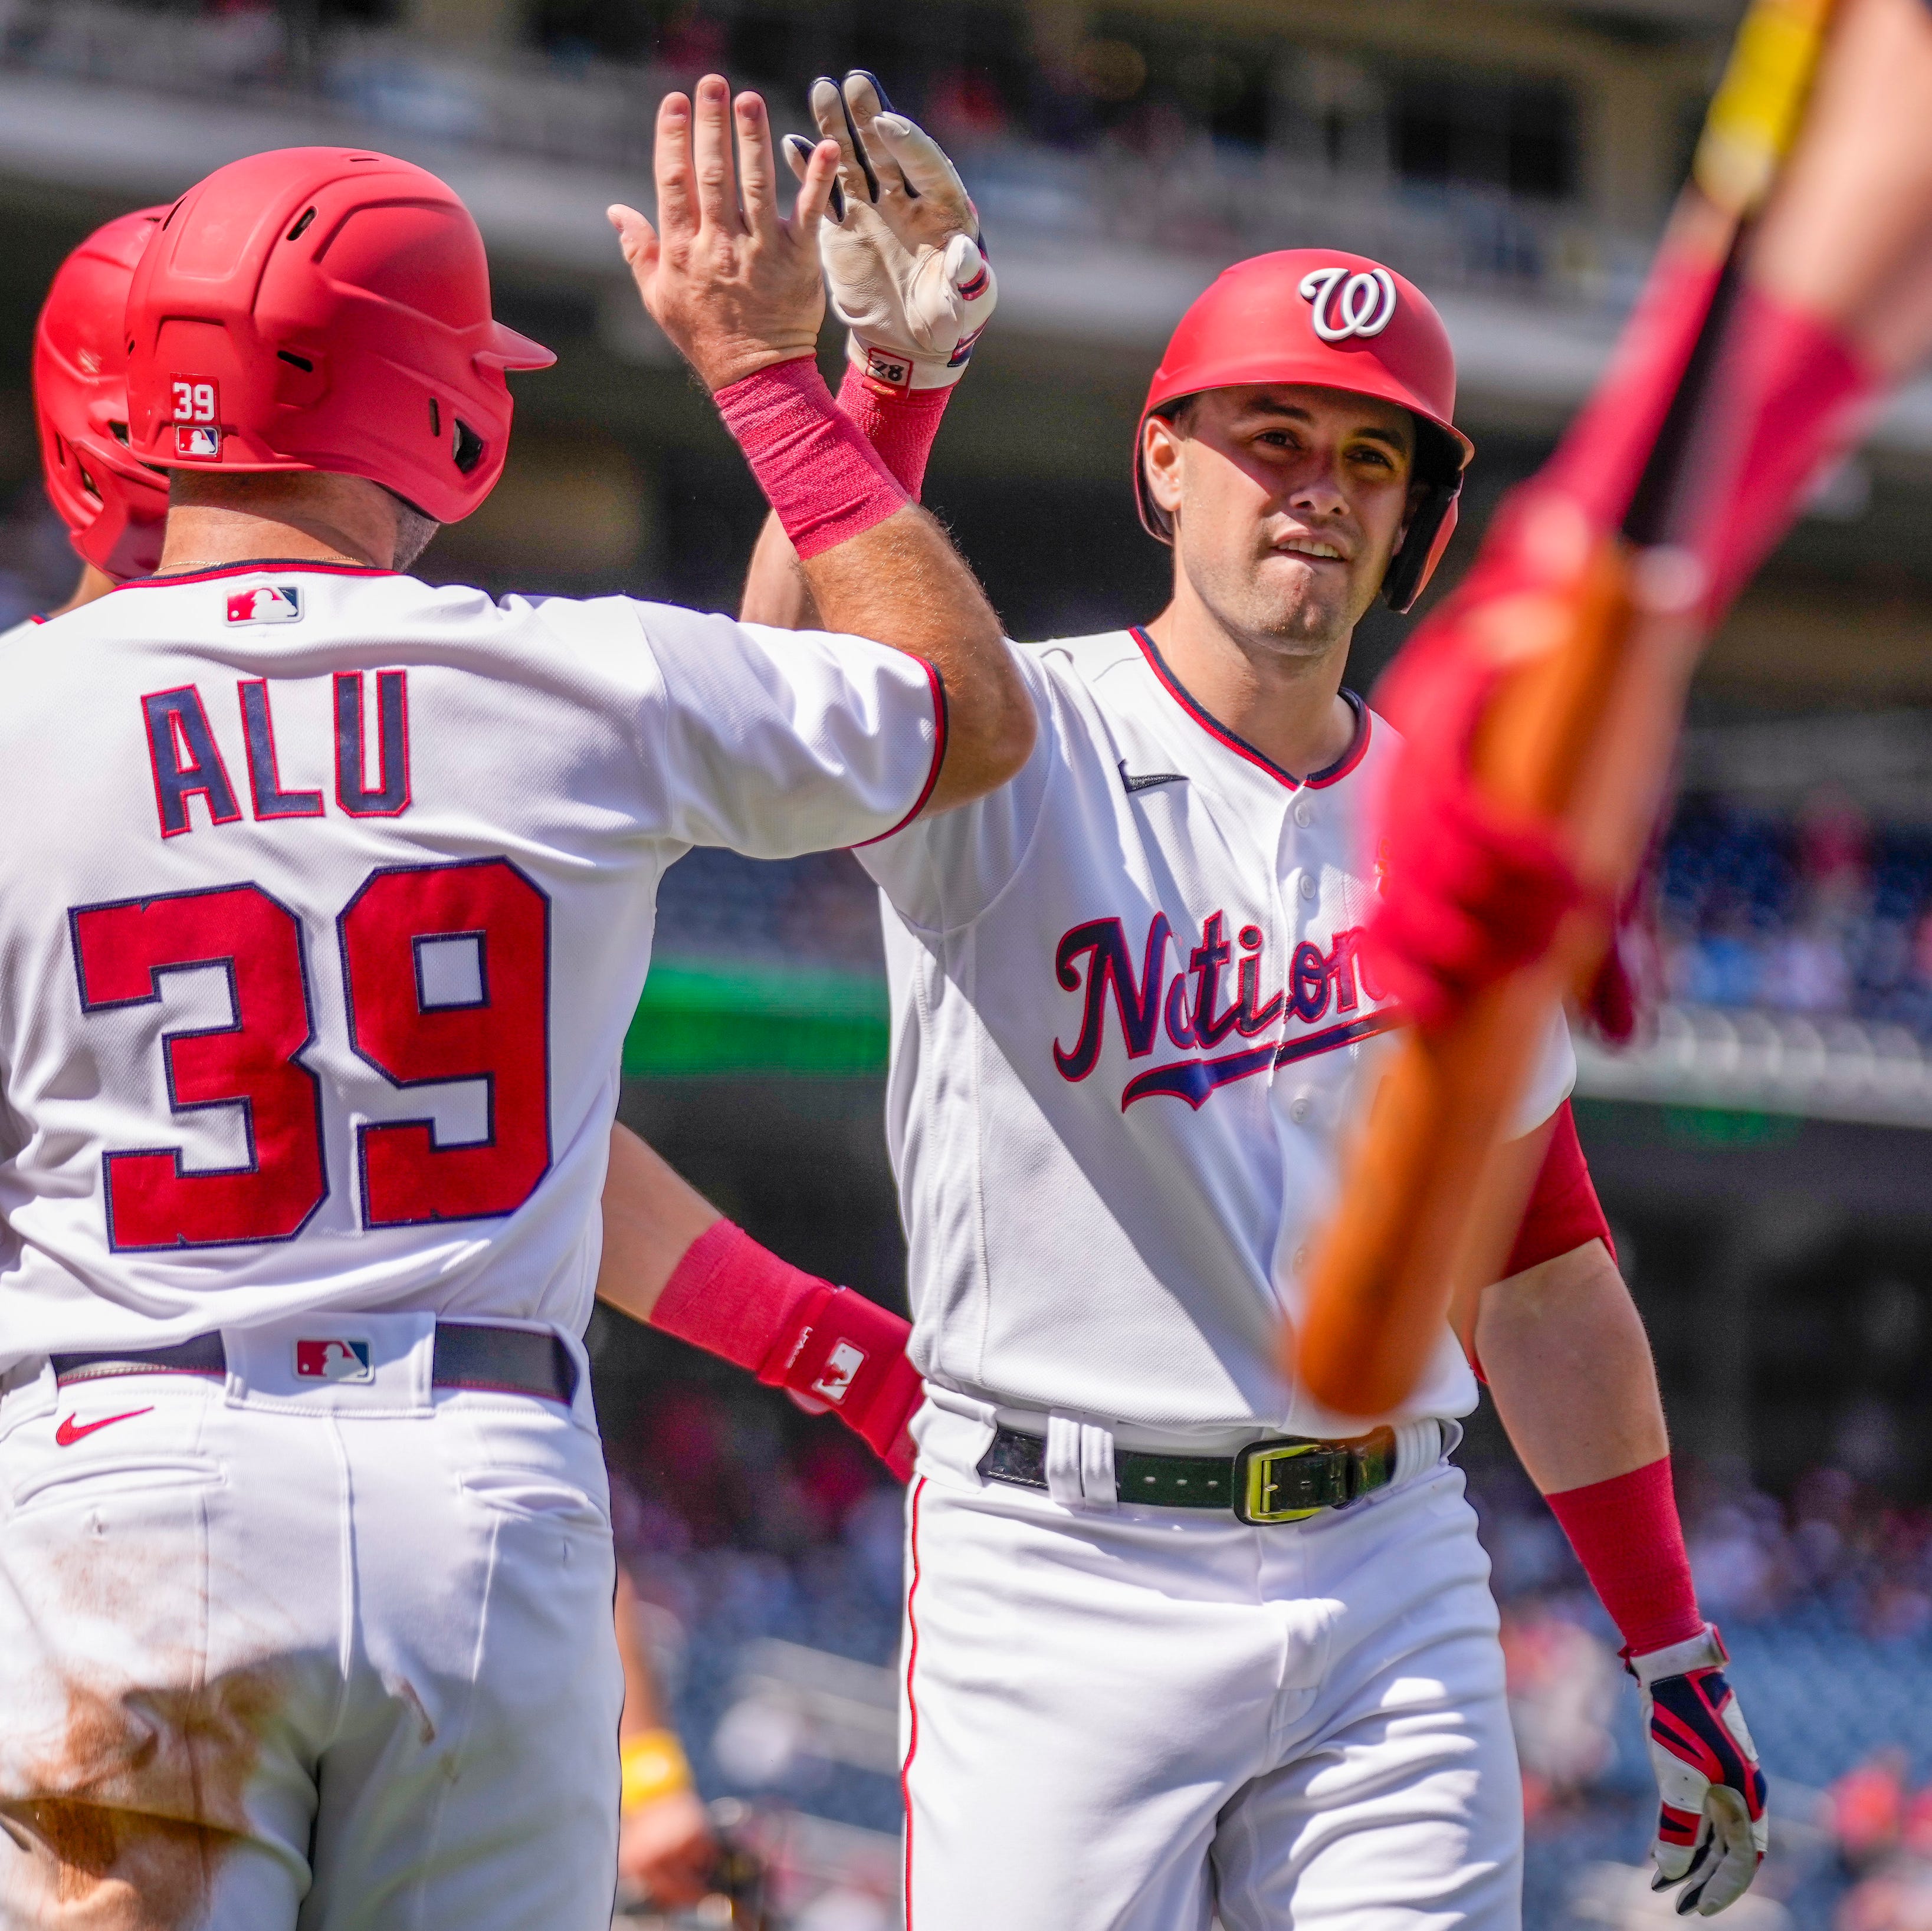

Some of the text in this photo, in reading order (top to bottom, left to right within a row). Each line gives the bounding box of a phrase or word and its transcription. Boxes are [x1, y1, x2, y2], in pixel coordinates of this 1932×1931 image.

[1300, 268, 1397, 341] W
[173, 382, 215, 421] 39
[873, 360, 904, 382] 28
[140, 669, 411, 839] ALU
[68, 855, 553, 1253] 39
[1054, 909, 1388, 1082] Nation
